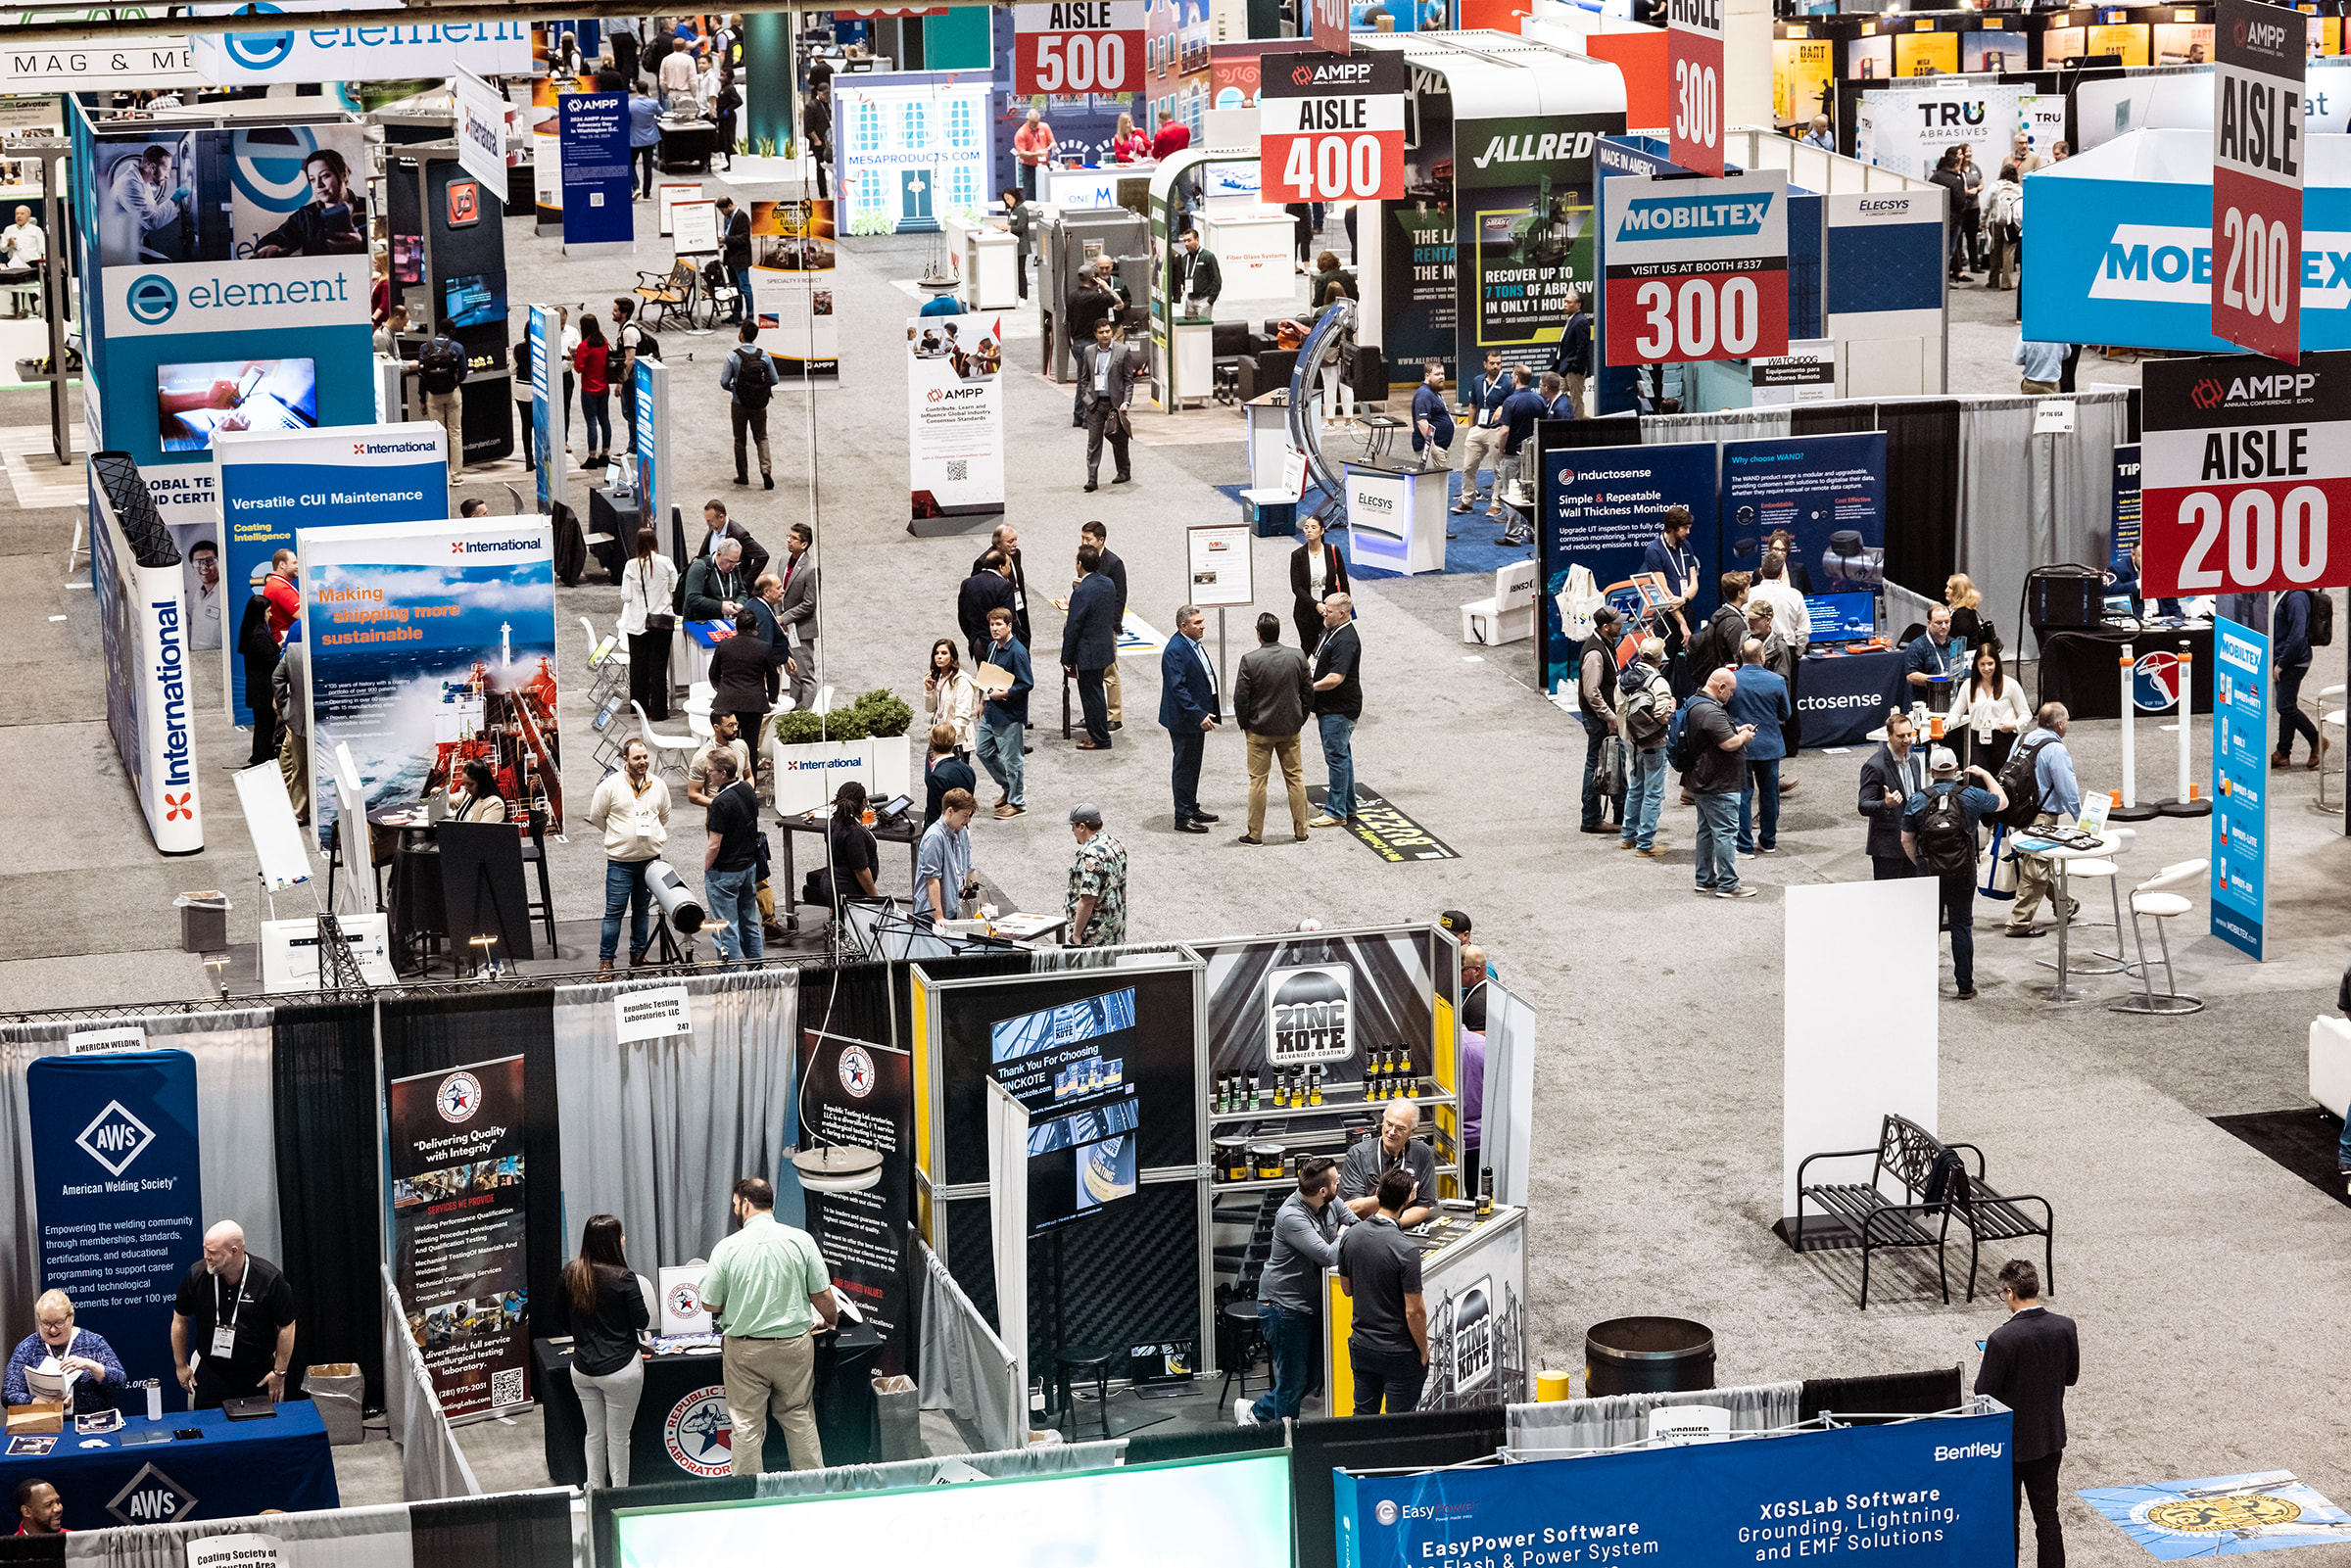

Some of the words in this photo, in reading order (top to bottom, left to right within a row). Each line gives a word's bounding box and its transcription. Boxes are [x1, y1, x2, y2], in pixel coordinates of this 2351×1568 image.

[1049, 2, 1112, 29] AISLE
[2247, 22, 2285, 49] AMPP
[15, 54, 87, 72] MAG
[112, 54, 128, 71] &
[1036, 33, 1126, 91] 500
[1314, 64, 1370, 80] AMPP
[583, 99, 619, 110] AMPP
[1676, 59, 1717, 148] 300
[1299, 99, 1367, 130] AISLE
[1918, 101, 1985, 126] TRU
[1920, 127, 1988, 138] ABRASIVES
[2220, 75, 2298, 177] AISLE
[849, 151, 980, 166] MESAPRODUCTS.COM
[1283, 134, 1381, 198] 400
[1601, 147, 1620, 168] MADE
[1069, 195, 1089, 204] ONE
[1624, 202, 1765, 231] MOBILTEX
[1414, 229, 1441, 245] THE
[1414, 265, 1439, 280] THE
[1486, 268, 1536, 283] RECOVER
[1540, 267, 1556, 281] UP
[1559, 266, 1573, 279] TO
[1631, 265, 1659, 275] VISIT
[1662, 264, 1677, 273] US
[1679, 263, 1693, 273] AT
[1696, 261, 1734, 272] BOOTH
[1737, 260, 1762, 269] #337
[2223, 206, 2289, 324] 200
[189, 272, 348, 309] element
[1486, 286, 1492, 299] 7
[1496, 285, 1523, 298] TONS
[1527, 284, 1541, 297] OF
[1486, 302, 1498, 313] IN
[1502, 300, 1529, 313] ONLY
[1532, 300, 1538, 311] 1
[1636, 276, 1758, 359] 300
[944, 388, 984, 400] AMPP
[2226, 374, 2316, 401] AMPP
[366, 441, 436, 454] International
[2201, 427, 2309, 481] AISLE
[1732, 455, 1748, 465] Why
[1750, 453, 1774, 462] choose
[1777, 452, 1804, 461] WAND?
[1577, 467, 1652, 481] inductosense
[232, 496, 295, 510] Versatile
[300, 493, 326, 505] CUI
[331, 490, 423, 504] Maintenance
[1559, 494, 1594, 505] Simple
[1607, 491, 1661, 503] Repeatable
[1559, 506, 1581, 517] Wall
[1583, 505, 1632, 516] Thickness
[233, 523, 272, 533] Coating
[234, 532, 291, 543] Intelligence
[1598, 524, 1630, 533] inspection
[466, 538, 541, 553] International
[2178, 486, 2328, 590] 200
[318, 587, 383, 603] Making
[334, 606, 409, 624] shipping
[414, 604, 460, 618] more
[321, 627, 423, 645] sustainable
[2221, 640, 2260, 667] MOBILTEX
[151, 598, 190, 786] International
[624, 1002, 652, 1014] Republic
[653, 999, 679, 1009] Testing
[624, 1010, 666, 1023] Laboratories
[668, 1008, 680, 1017] LLC
[677, 1022, 690, 1031] 247
[1275, 1004, 1345, 1031] ZINC
[75, 1042, 110, 1054] AMERICAN
[111, 1039, 140, 1048] WELDING
[1276, 1026, 1345, 1054] KOTE
[998, 1063, 1025, 1078] Thank
[1026, 1059, 1042, 1071] You
[1044, 1054, 1058, 1066] For
[1060, 1045, 1099, 1064] Choosing
[1276, 1052, 1316, 1061] GALVANIZED
[97, 1124, 136, 1151] AWS
[470, 1126, 507, 1139] Quality
[426, 1152, 449, 1163] with
[62, 1183, 103, 1197] American
[105, 1181, 139, 1193] Welding
[141, 1177, 173, 1190] Society
[427, 1202, 457, 1215] SERVICES
[468, 1194, 495, 1208] PROVIDE
[45, 1222, 96, 1235] Empowering
[98, 1222, 112, 1231] the
[114, 1219, 146, 1231] welding
[148, 1215, 194, 1227] community
[414, 1222, 439, 1232] Welding
[439, 1215, 476, 1227] Performance
[414, 1236, 439, 1245] Welding
[439, 1229, 469, 1240] Procedure
[470, 1221, 508, 1234] Development
[46, 1239, 77, 1250] through
[79, 1233, 138, 1247] memberships,
[139, 1230, 183, 1243] standards,
[466, 1235, 488, 1245] Testing
[46, 1252, 102, 1265] certifications,
[104, 1251, 120, 1259] and
[121, 1247, 168, 1258] educational
[415, 1256, 448, 1267] Mechanical
[47, 1267, 103, 1281] programming
[105, 1266, 114, 1275] to
[115, 1264, 146, 1276] support
[148, 1262, 174, 1272] career
[416, 1278, 444, 1289] Technical
[477, 1266, 503, 1277] Services
[79, 1284, 95, 1293] and
[97, 1279, 151, 1293] technological
[111, 1297, 122, 1306] for
[124, 1296, 142, 1305] over
[145, 1294, 160, 1303] 100
[416, 1292, 439, 1303] Coupon
[440, 1289, 456, 1298] Sales
[425, 1343, 469, 1359] diversified,
[470, 1340, 483, 1351] full
[484, 1336, 511, 1348] service
[1457, 1318, 1489, 1359] ZINC
[477, 1347, 504, 1358] testing
[442, 1361, 488, 1376] laboratory.
[1458, 1342, 1489, 1383] KOTE
[668, 1387, 719, 1428] REPUBLIC
[1934, 1442, 2002, 1461] Bentley
[130, 1490, 176, 1518] AWS
[1402, 1499, 1479, 1522] EasyPower
[1760, 1497, 1839, 1520] XGSLab
[1846, 1489, 1941, 1510] Software
[1738, 1519, 1849, 1544] Grounding,
[1857, 1506, 1960, 1531] Lightning,
[1422, 1531, 1535, 1560] EasyPower
[1543, 1522, 1640, 1544] Software
[1755, 1544, 1792, 1561] and
[1799, 1537, 1841, 1556] EMF
[1847, 1528, 1943, 1550] Solutions
[197, 1551, 231, 1566] Coating
[232, 1550, 266, 1560] Society
[268, 1549, 277, 1558] of
[1503, 1553, 1515, 1567] &
[1522, 1549, 1581, 1568] Power
[1588, 1539, 1659, 1564] System
